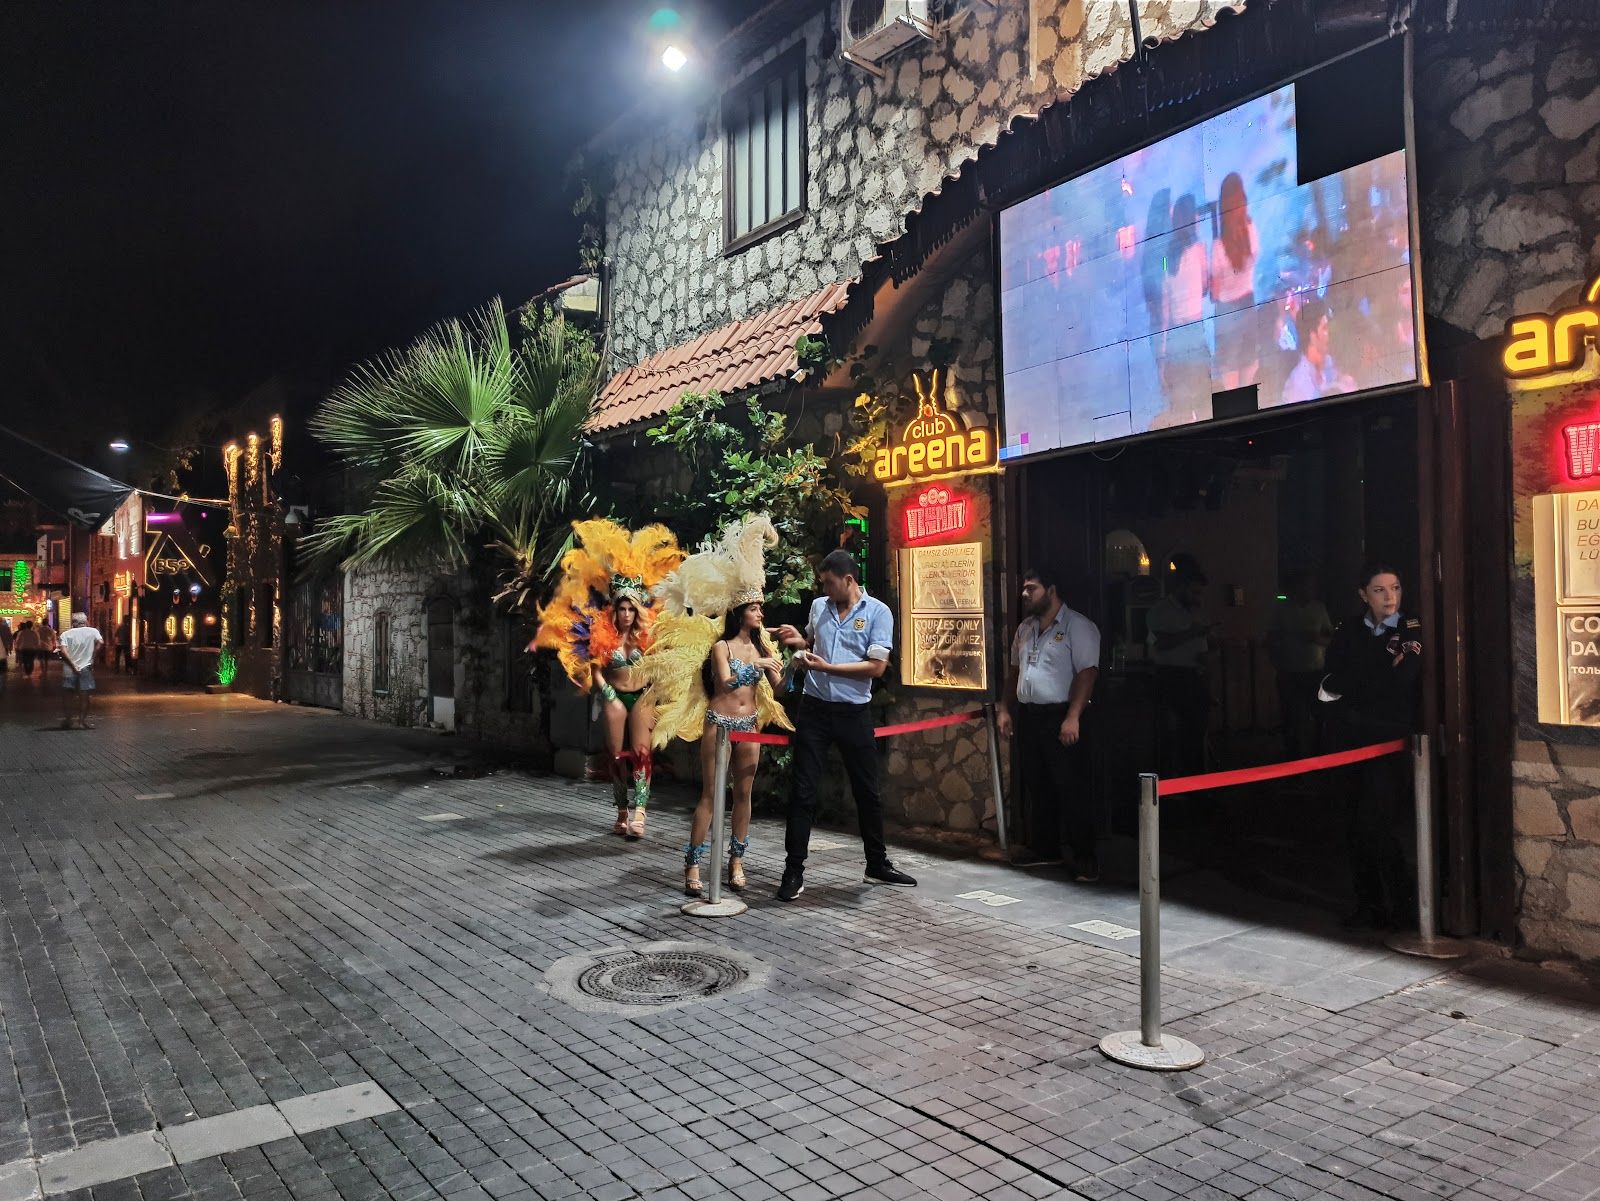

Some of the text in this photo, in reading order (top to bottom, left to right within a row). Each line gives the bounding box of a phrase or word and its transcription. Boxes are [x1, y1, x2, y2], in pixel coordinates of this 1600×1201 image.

[912, 418, 946, 439] club
[874, 430, 987, 478] areena
[956, 620, 980, 631] ONLY
